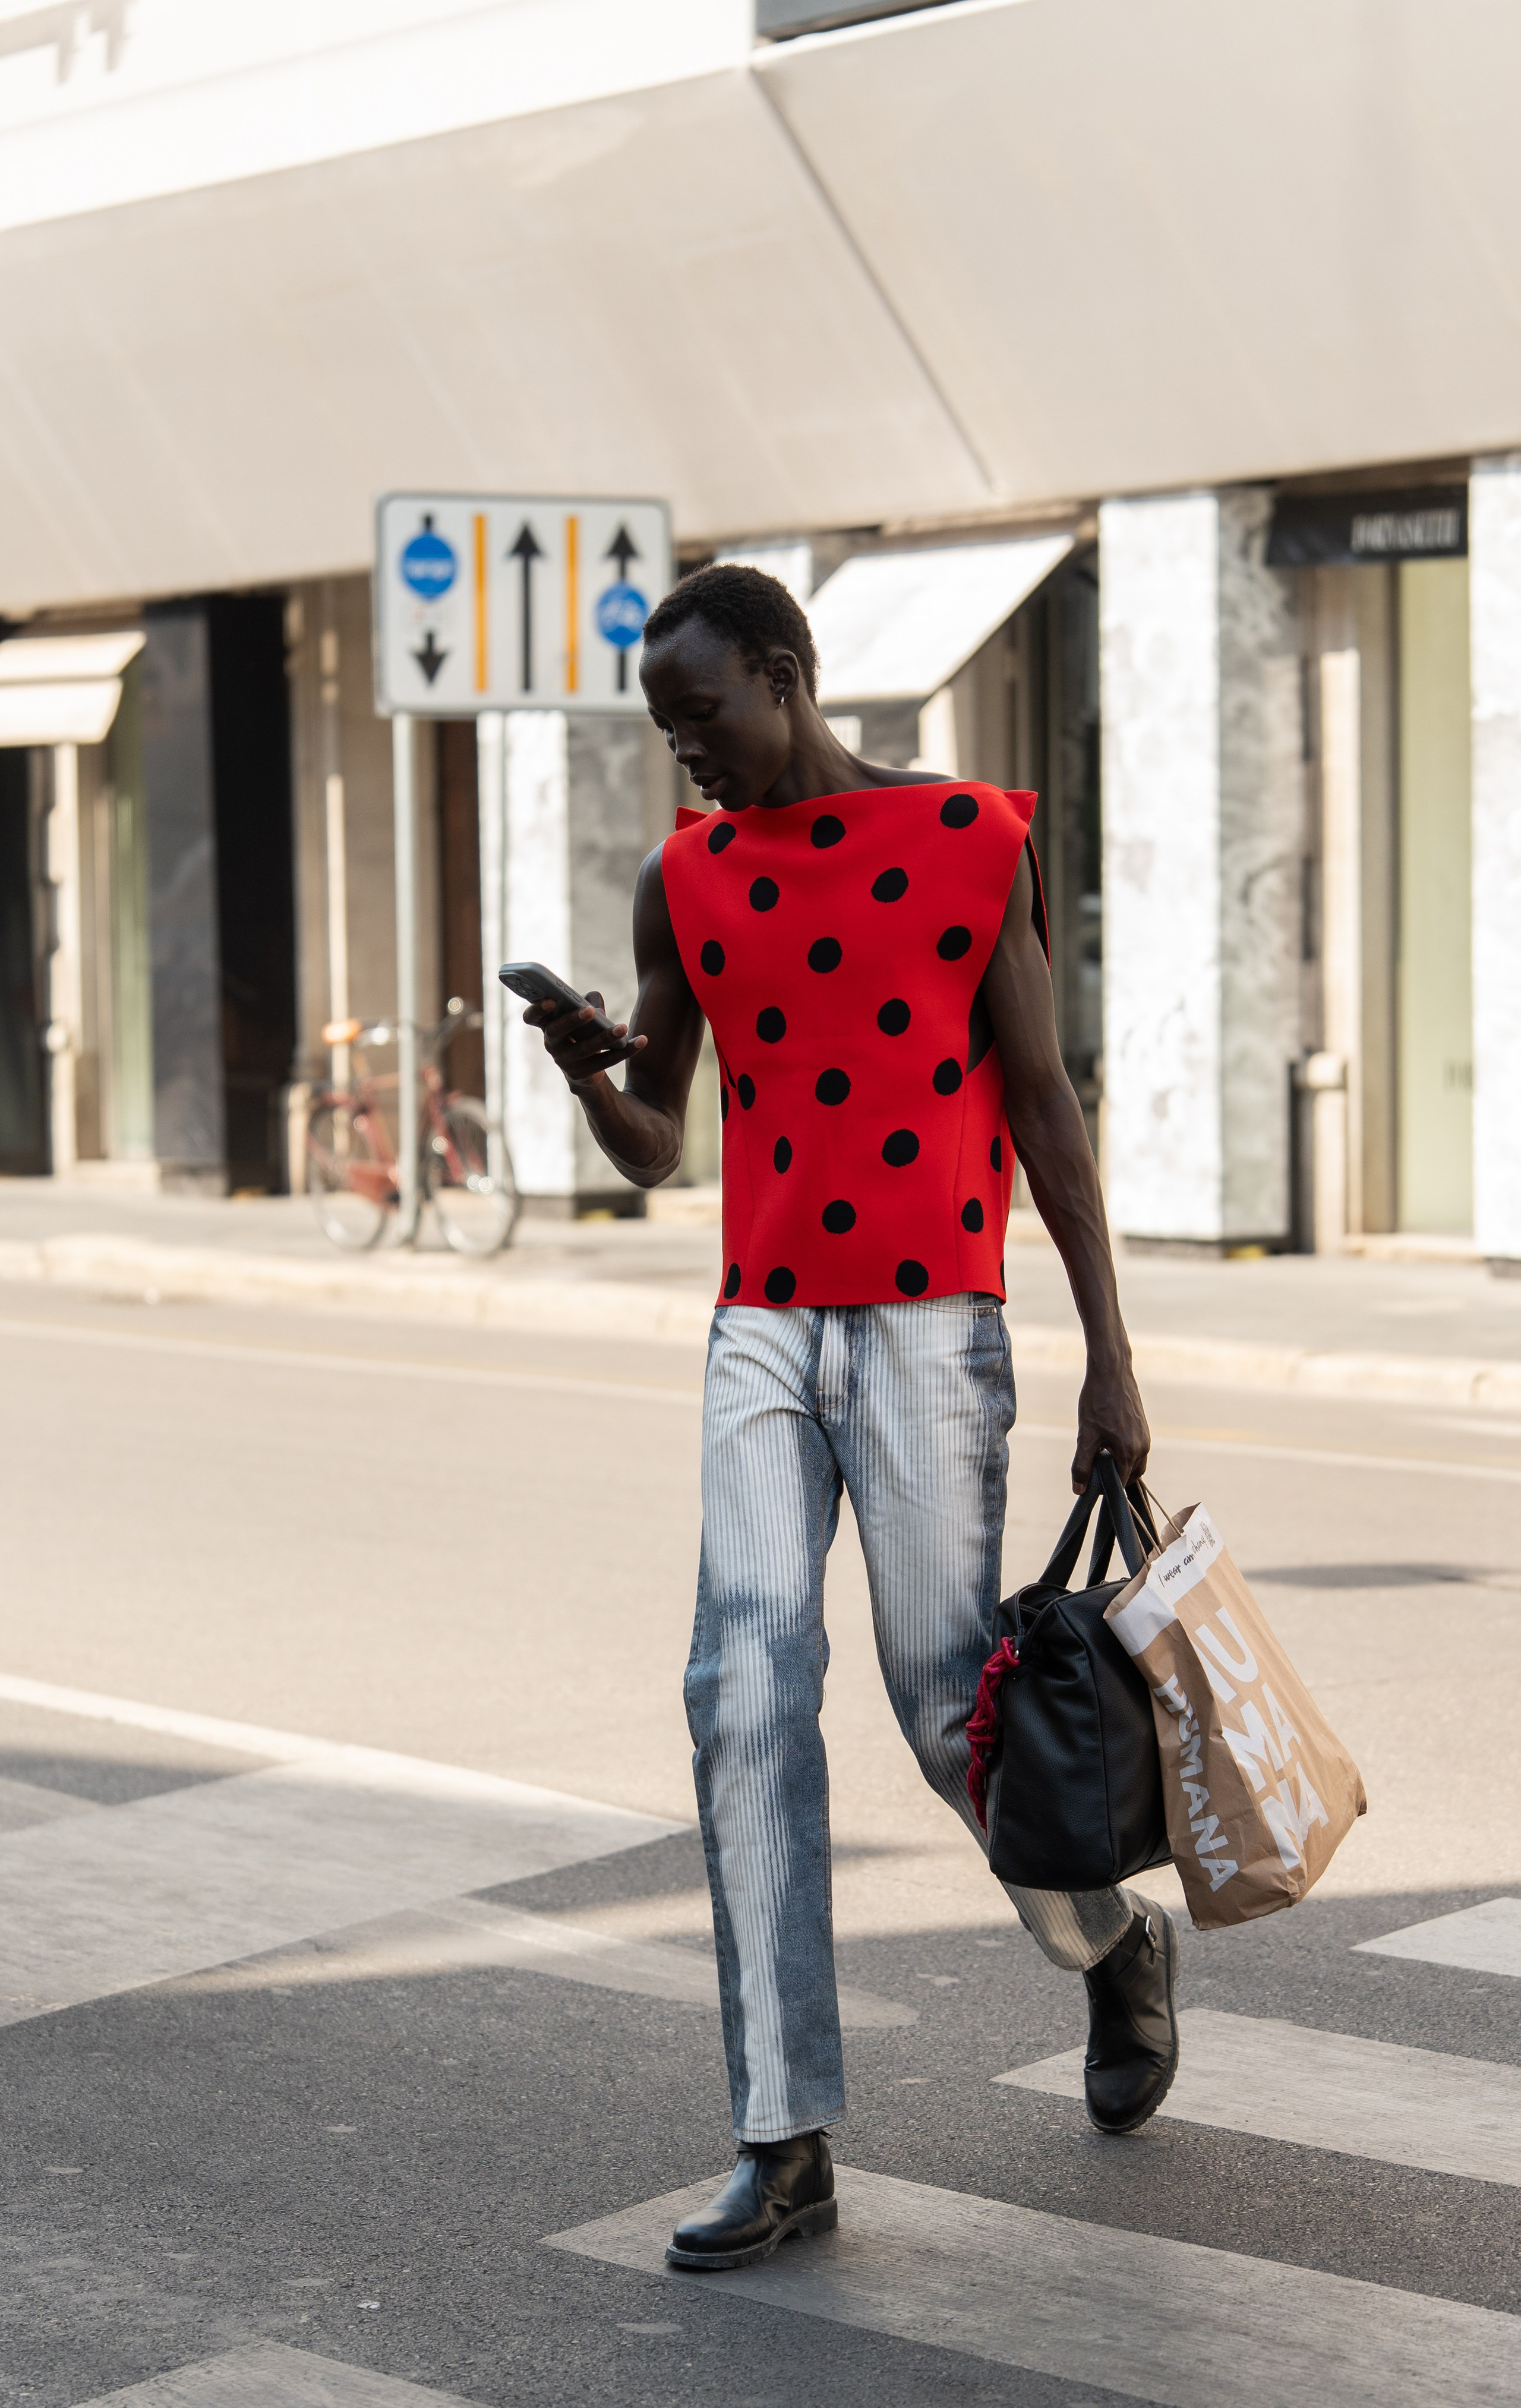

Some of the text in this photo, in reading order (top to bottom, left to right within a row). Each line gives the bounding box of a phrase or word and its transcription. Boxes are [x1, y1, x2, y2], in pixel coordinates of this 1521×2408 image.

[1153, 1673, 1239, 1892] HUMANA
[1222, 1683, 1302, 1793] MA
[1260, 1761, 1330, 1870] NA
